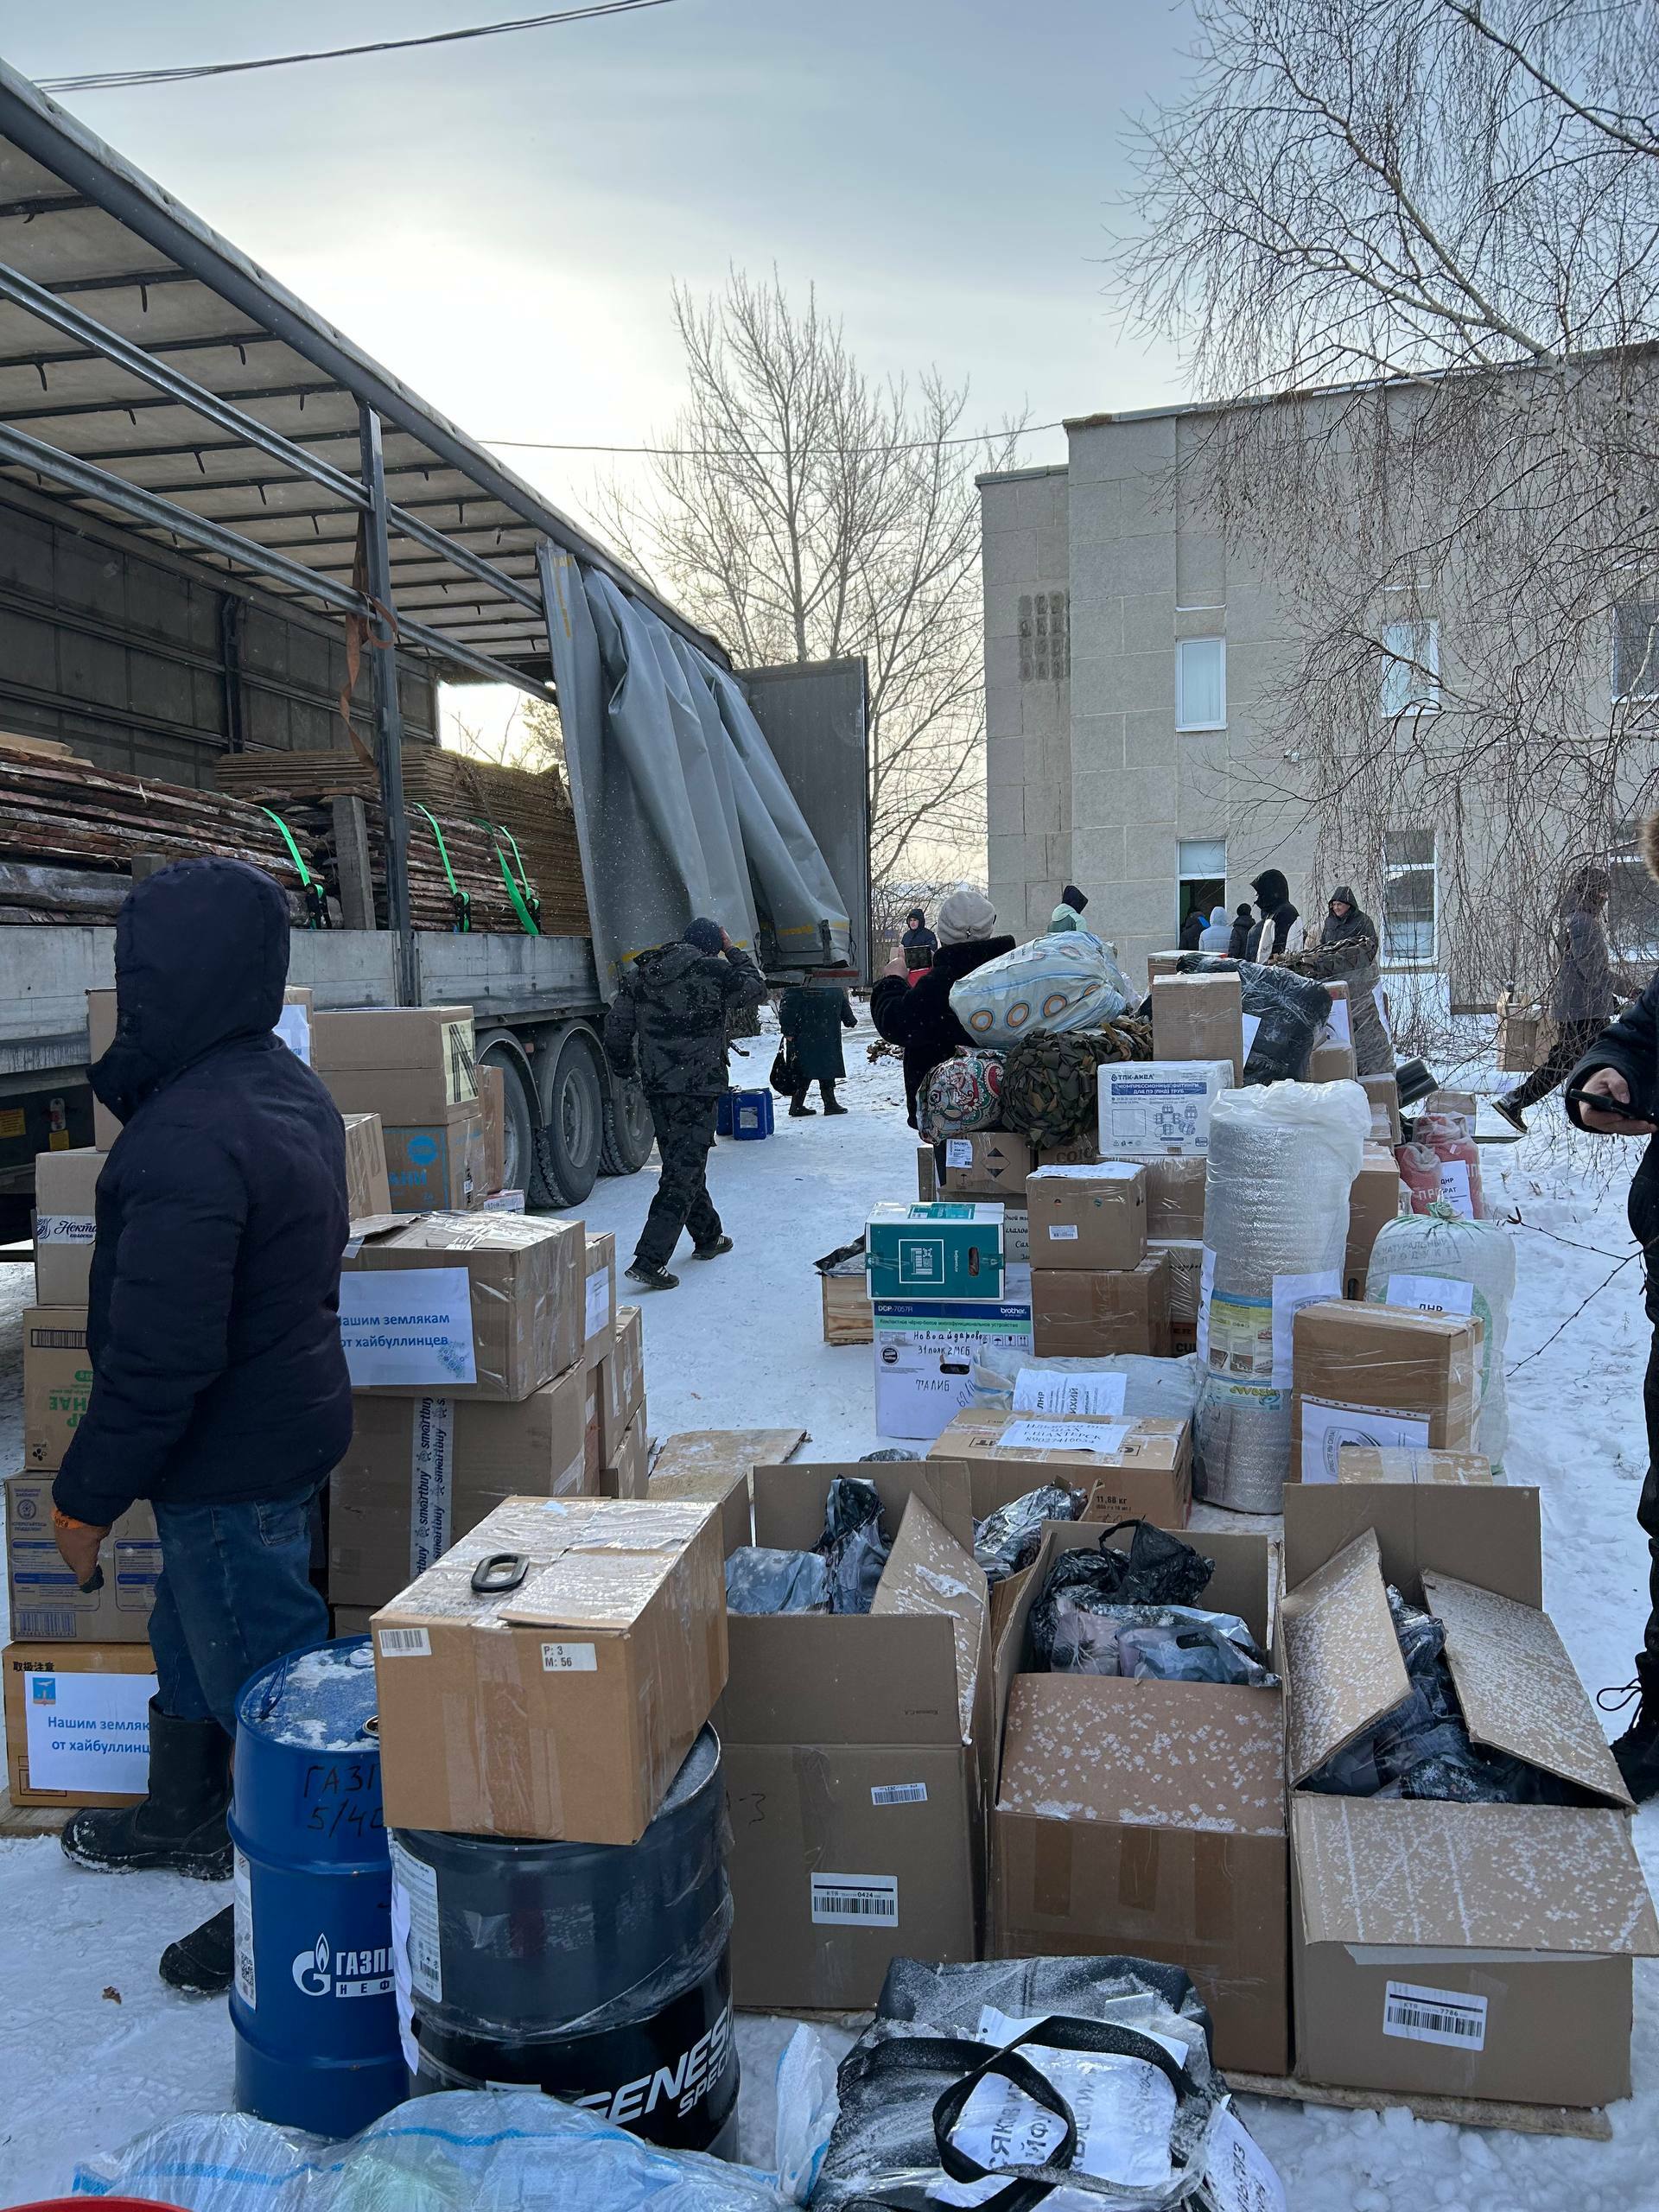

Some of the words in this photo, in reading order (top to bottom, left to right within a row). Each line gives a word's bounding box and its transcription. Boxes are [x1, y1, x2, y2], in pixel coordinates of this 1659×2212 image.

[383, 1313, 450, 1325] землякам
[355, 1334, 448, 1349] хайбуллинцев
[556, 1645, 563, 1656] 3
[13, 1661, 55, 1672] 取扱注意
[545, 1657, 558, 1667] M:
[560, 1656, 572, 1667] 56
[48, 1716, 97, 1729] Нашим
[99, 1719, 150, 1731] земляк
[52, 1740, 67, 1751] от
[69, 1738, 150, 1755] хайбуллинц
[336, 1946, 395, 1976] ГАЗП
[340, 1980, 391, 1995] НЕФ
[1440, 2008, 1459, 2017] 7786
